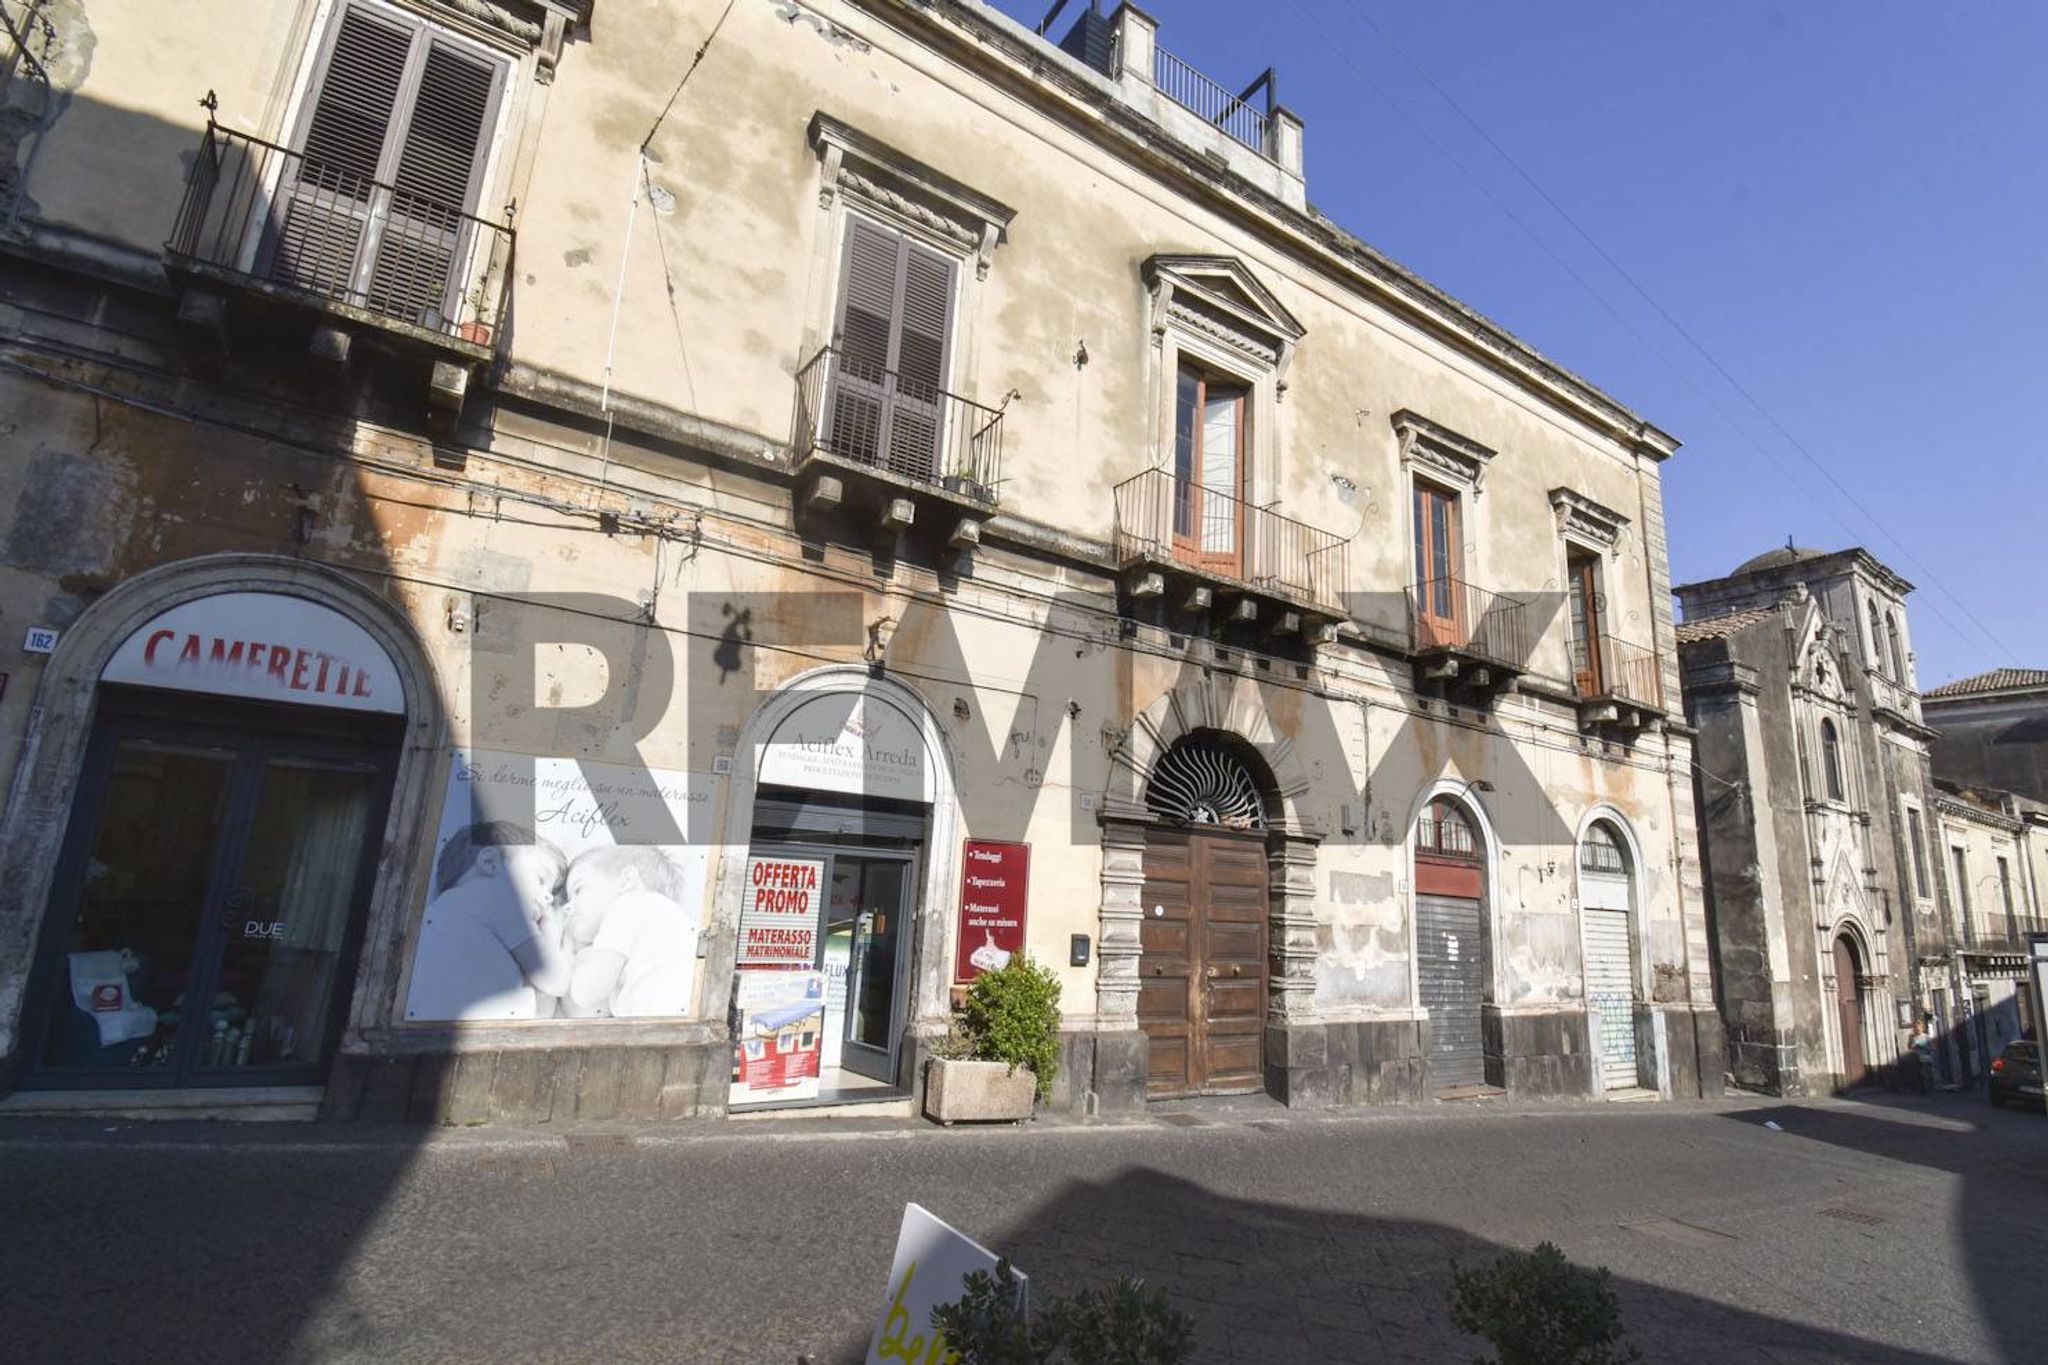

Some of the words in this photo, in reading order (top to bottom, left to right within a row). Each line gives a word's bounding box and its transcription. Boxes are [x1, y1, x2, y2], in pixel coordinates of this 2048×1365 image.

[31, 632, 53, 649] 162
[792, 731, 855, 757] Aciflex
[863, 744, 917, 768] Arreda
[535, 798, 630, 838] Aciflex
[752, 862, 816, 889] OFFERTA
[755, 888, 808, 914] PROMO
[244, 920, 287, 935] DUE
[748, 928, 811, 945] MATERASSO
[746, 945, 810, 958] MATRIMONIALE
